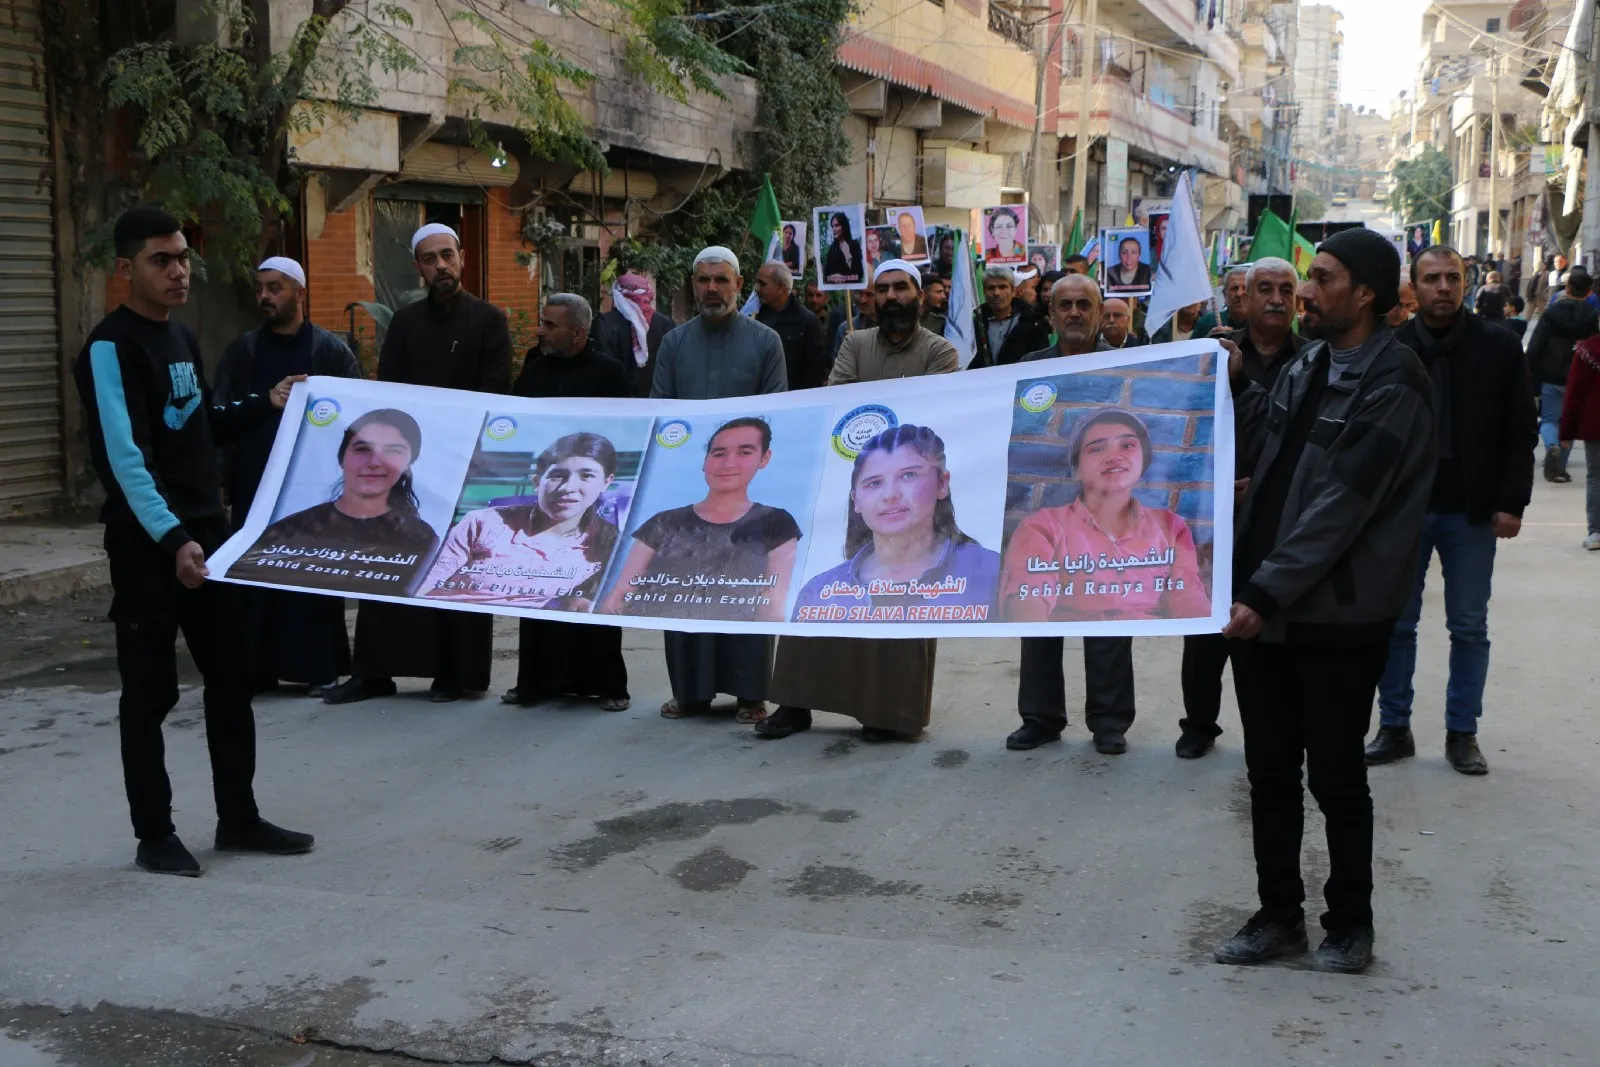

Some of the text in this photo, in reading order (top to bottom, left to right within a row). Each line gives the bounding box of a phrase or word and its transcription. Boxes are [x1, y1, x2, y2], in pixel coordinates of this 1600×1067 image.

[262, 544, 418, 566] الشهيدة زوزان زيدان
[1026, 547, 1176, 575] الشهيدة رانيا عطا
[305, 564, 349, 576] Zozan
[514, 565, 577, 579] الشهيدة
[681, 573, 716, 587] ديلان
[717, 573, 778, 588] الشهيدة
[820, 575, 967, 600] الشهيدة سلافا رمضان
[1019, 577, 1186, 601] Şehîd Ranya Eta
[848, 605, 904, 622] SILAVA
[905, 604, 990, 622] REMEDAN
